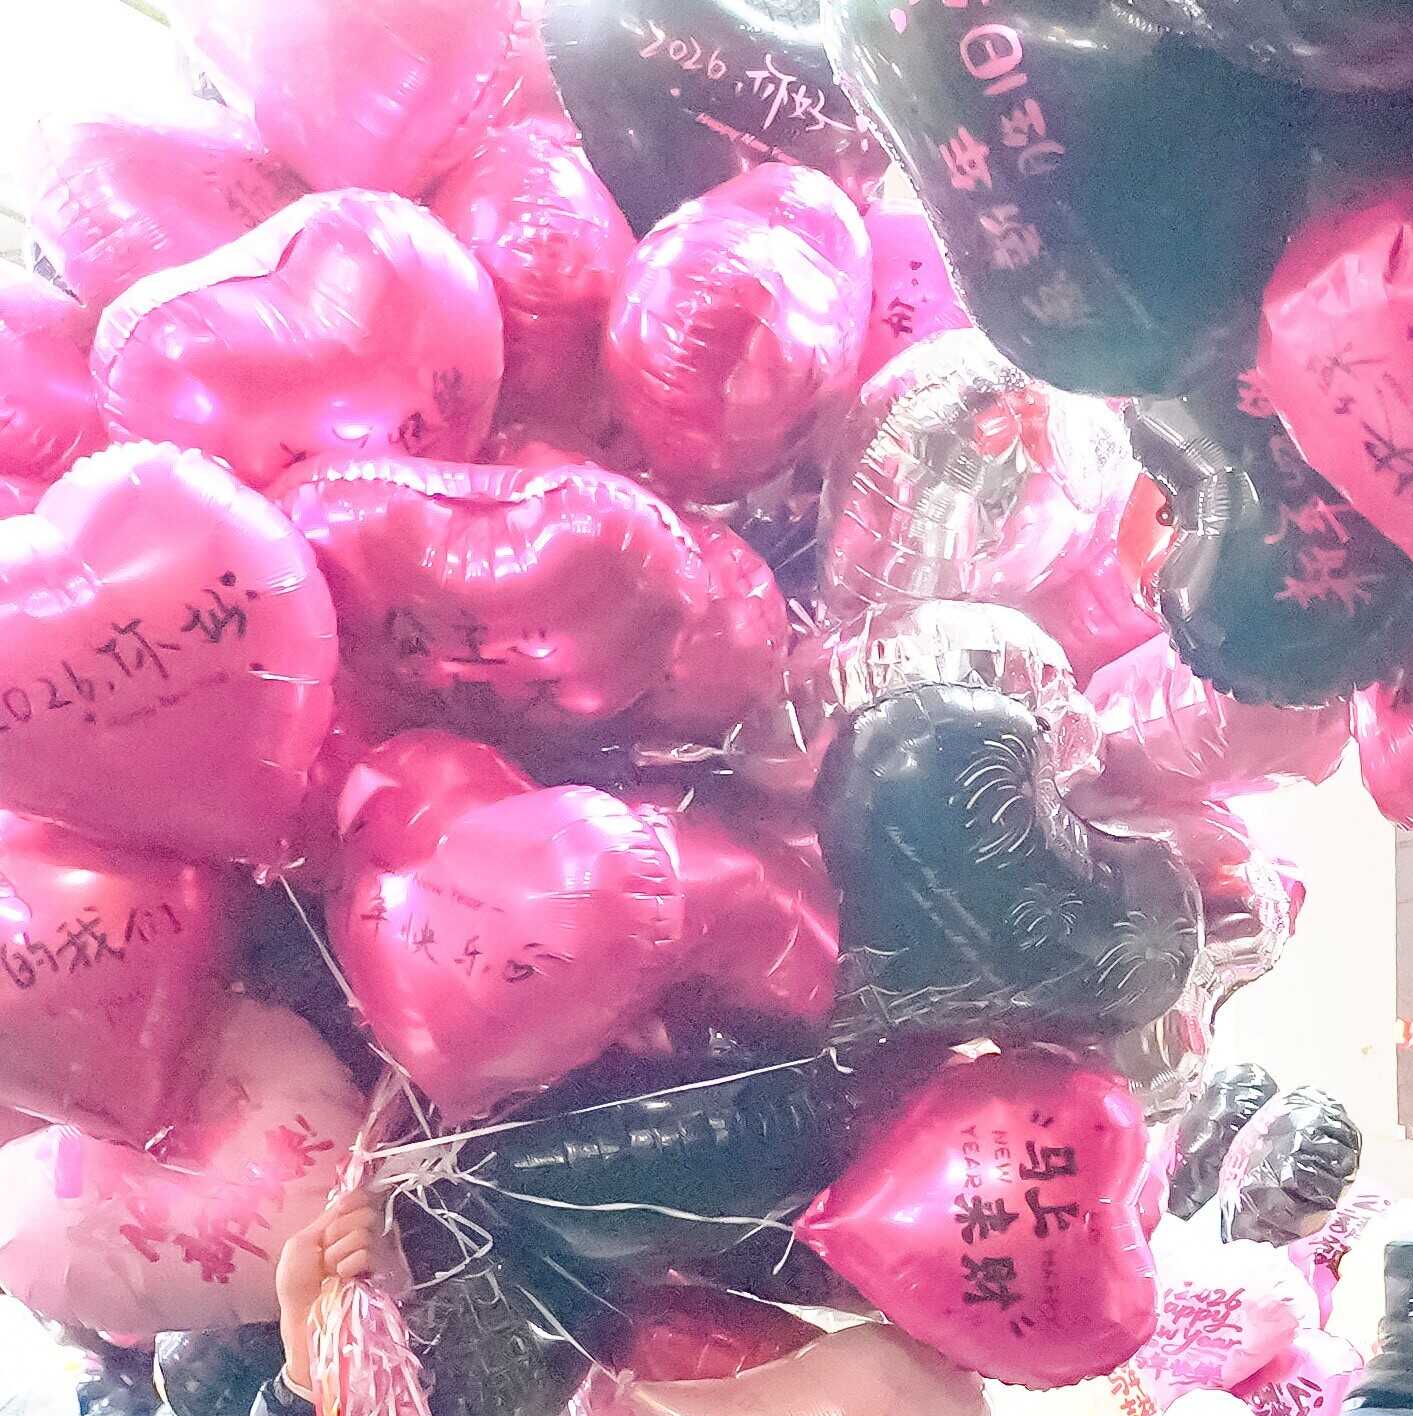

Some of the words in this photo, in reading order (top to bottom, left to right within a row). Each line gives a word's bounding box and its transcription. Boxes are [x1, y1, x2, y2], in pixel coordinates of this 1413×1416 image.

[960, 1124, 983, 1189] YEAR
[991, 1129, 1012, 1184] NEW
[1018, 1139, 1079, 1239] 马上
[954, 1193, 1022, 1311] 来财
